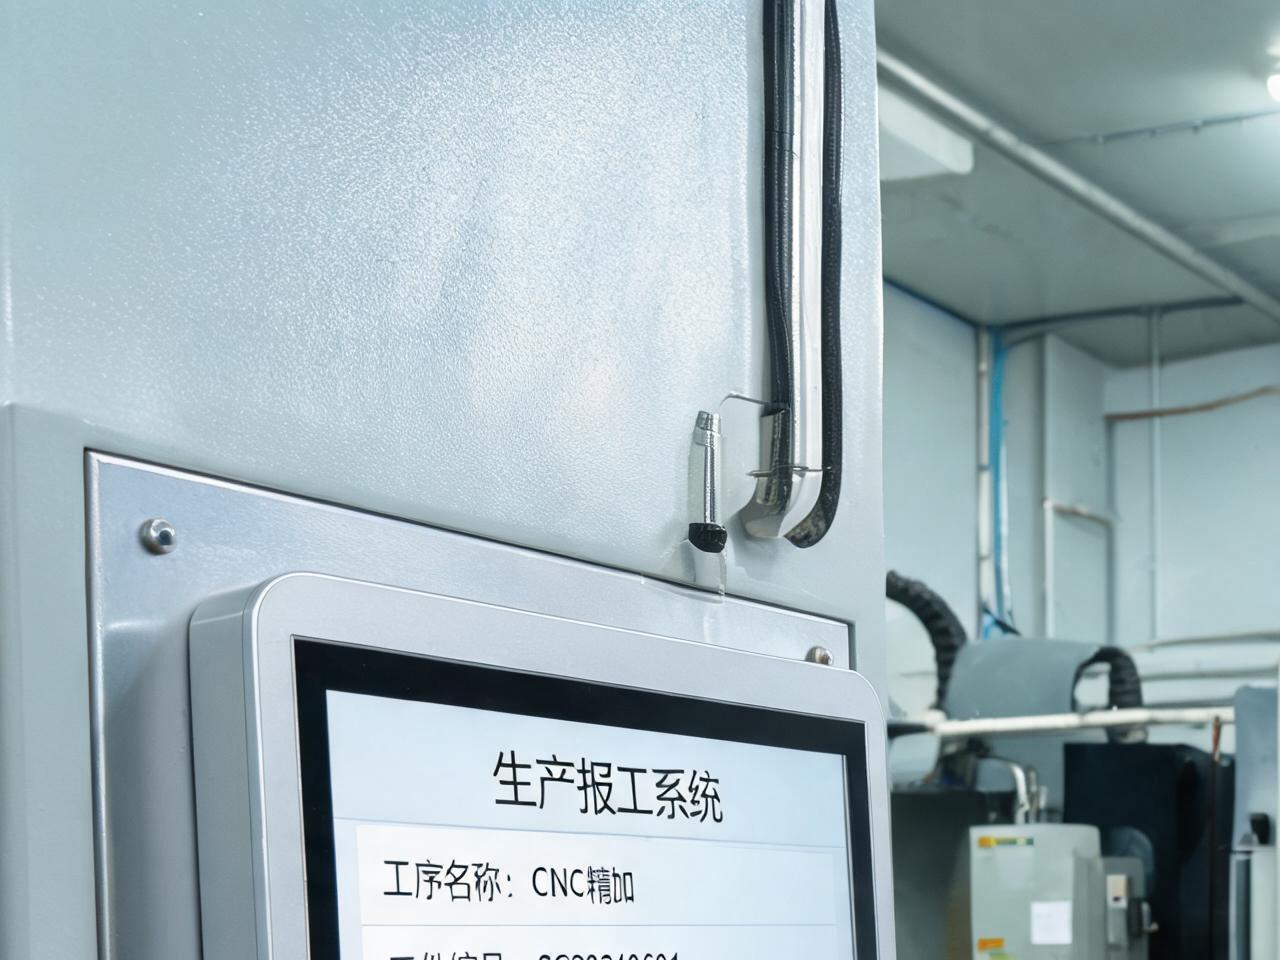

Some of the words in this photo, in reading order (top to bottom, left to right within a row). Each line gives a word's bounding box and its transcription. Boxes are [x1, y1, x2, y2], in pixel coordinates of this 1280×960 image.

[493, 750, 723, 823] 生产报工系统
